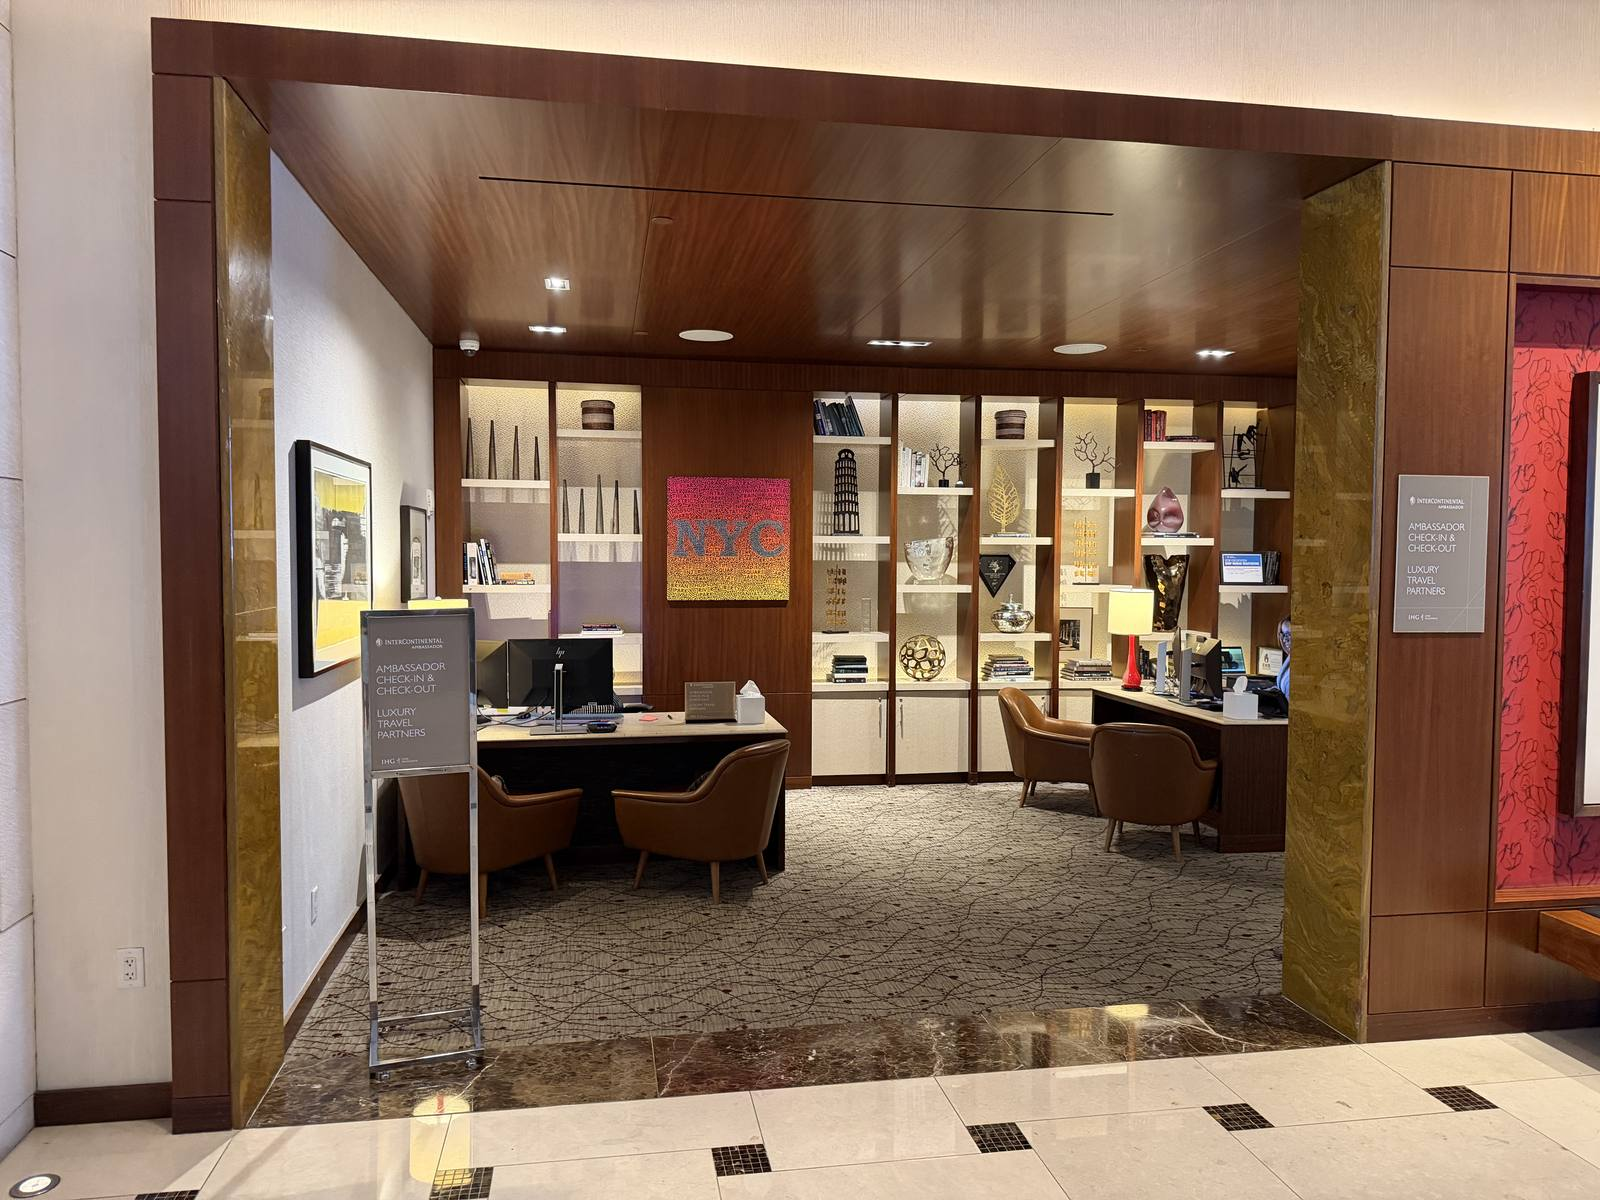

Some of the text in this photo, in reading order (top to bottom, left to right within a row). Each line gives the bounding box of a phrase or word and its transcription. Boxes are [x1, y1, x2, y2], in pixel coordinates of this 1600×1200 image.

[1408, 522, 1465, 532] AMBASSADOR
[672, 518, 785, 558] NYC
[1408, 533, 1456, 542] CHECK-IN &
[1407, 544, 1457, 553] CHECK-OUT
[1407, 565, 1440, 574] LUXURY
[1407, 576, 1436, 585] TRAVEL
[1406, 586, 1446, 596] PARTNERS
[555, 647, 565, 658] hp
[375, 662, 446, 674] AMBASSADOR
[376, 673, 435, 685] CHECK-IN &
[376, 684, 437, 696] CHECK-OUT
[376, 707, 417, 718] LUXURY
[377, 718, 413, 728] TRAVEL
[377, 728, 426, 740] PARTNERS
